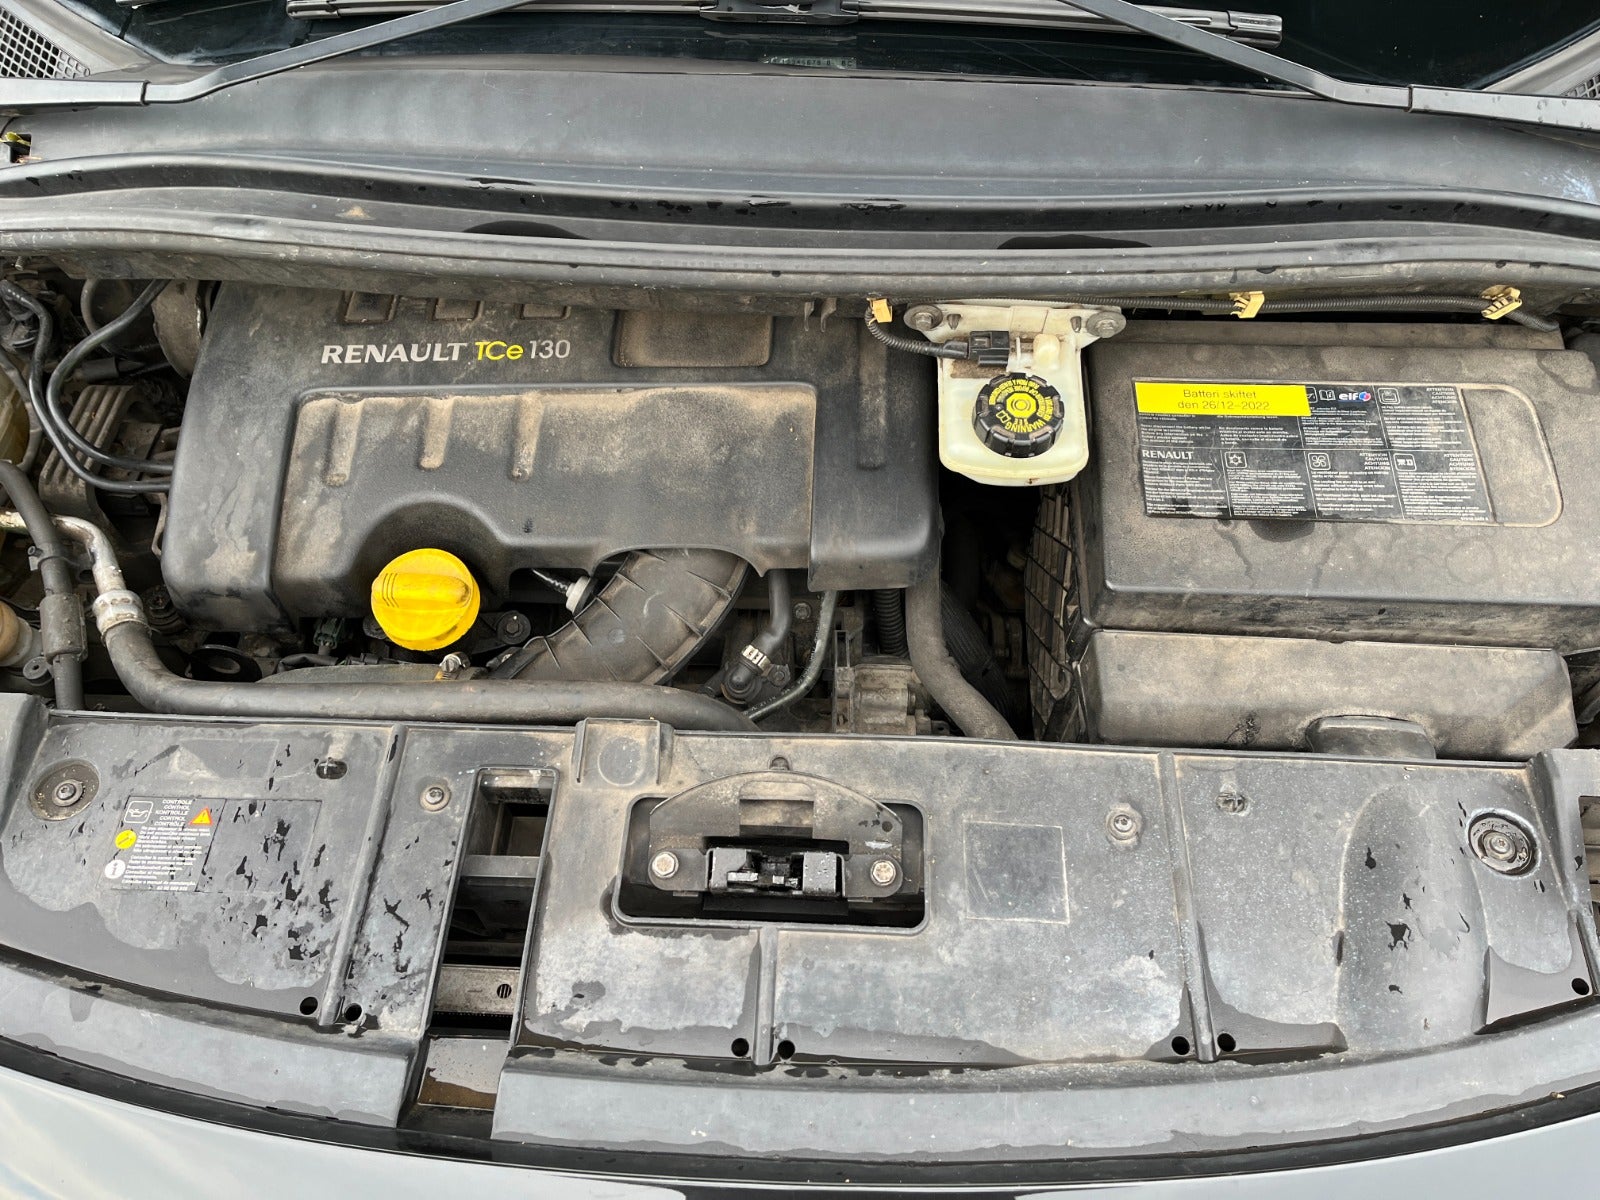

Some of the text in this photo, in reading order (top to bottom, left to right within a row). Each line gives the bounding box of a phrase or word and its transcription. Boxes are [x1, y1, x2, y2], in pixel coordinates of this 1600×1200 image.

[321, 340, 570, 364] RENAULT TCe 130
[1184, 389, 1220, 398] Batteri
[1338, 392, 1359, 400] elf
[1178, 400, 1270, 410] den 26/12-2022
[1005, 419, 1046, 432] WARNING
[1142, 449, 1194, 460] RENAULT
